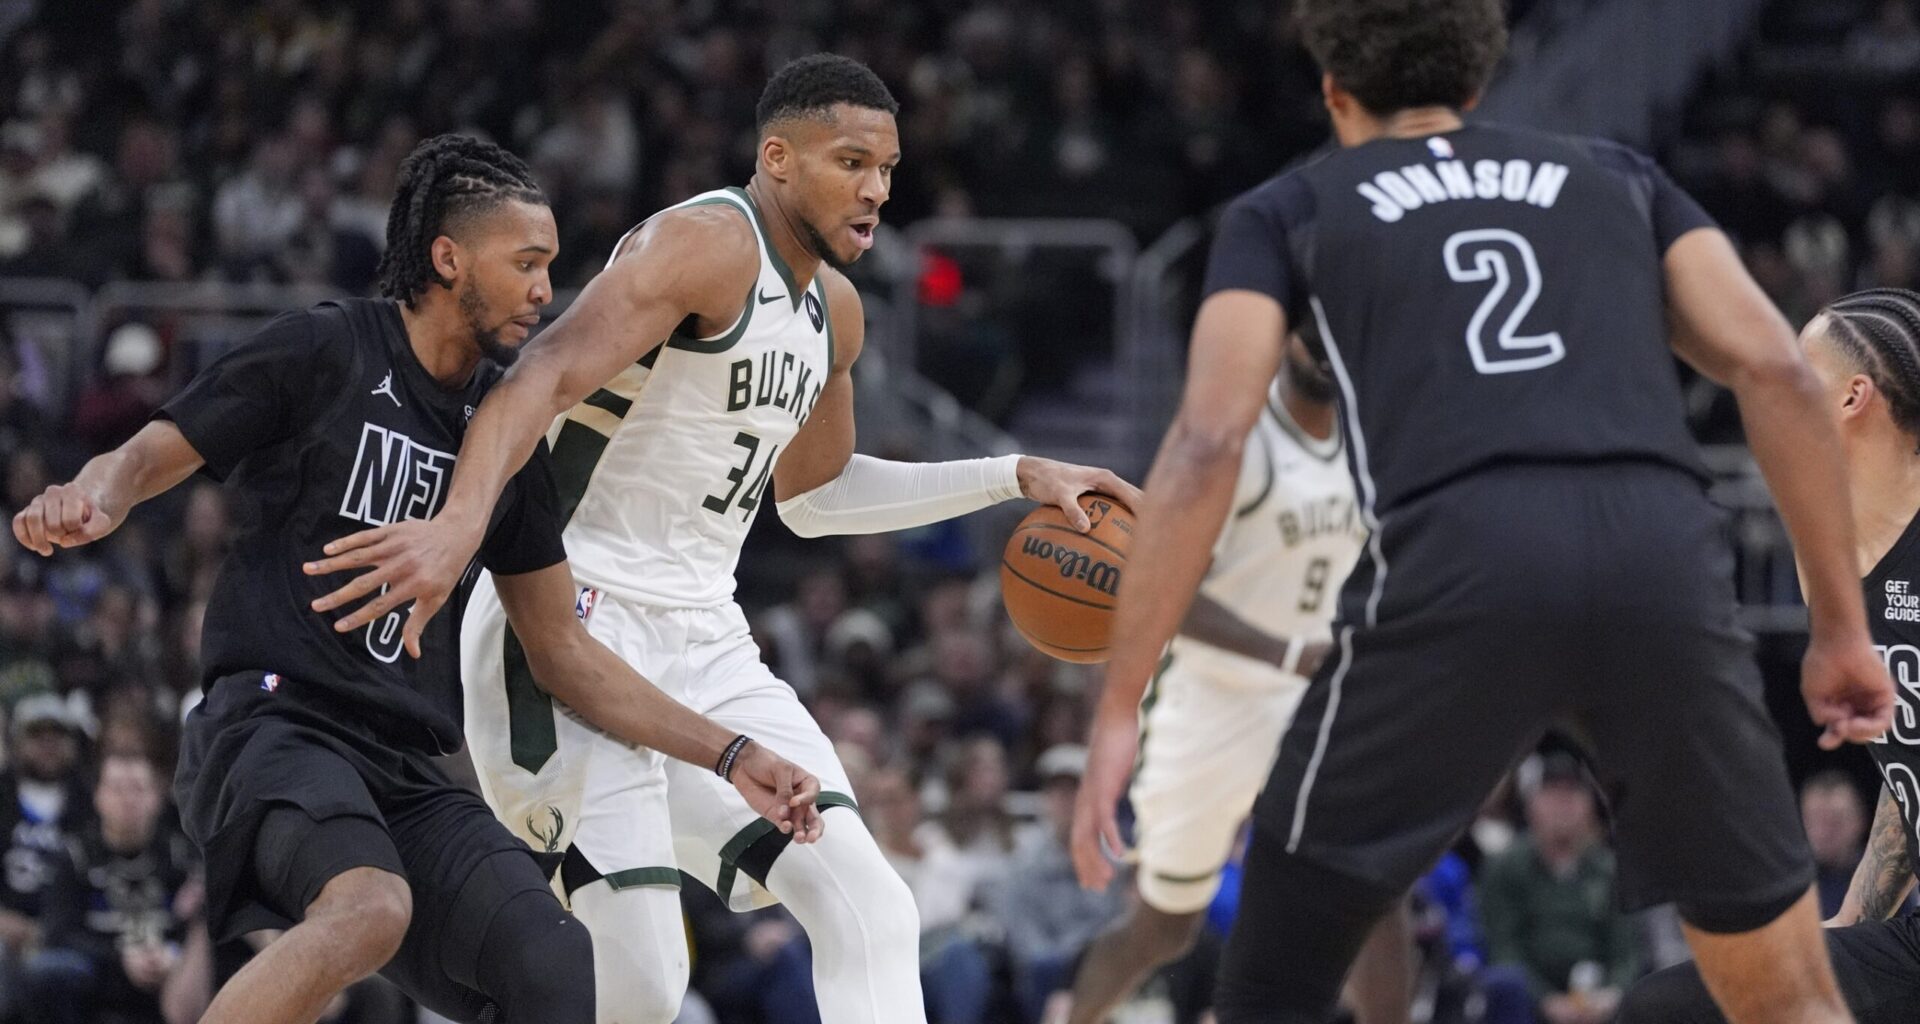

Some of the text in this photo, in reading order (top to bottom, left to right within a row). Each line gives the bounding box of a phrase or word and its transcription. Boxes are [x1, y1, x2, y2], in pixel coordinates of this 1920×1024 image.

[1356, 158, 1570, 223] JOHNSON
[1442, 227, 1566, 375] 2
[702, 431, 778, 523] 34
[1022, 535, 1121, 597] Wilson
[1296, 557, 1331, 613] 9
[1885, 579, 1910, 594] GET
[1884, 606, 1920, 622] GUIDE
[1885, 593, 1920, 609] YOUR
